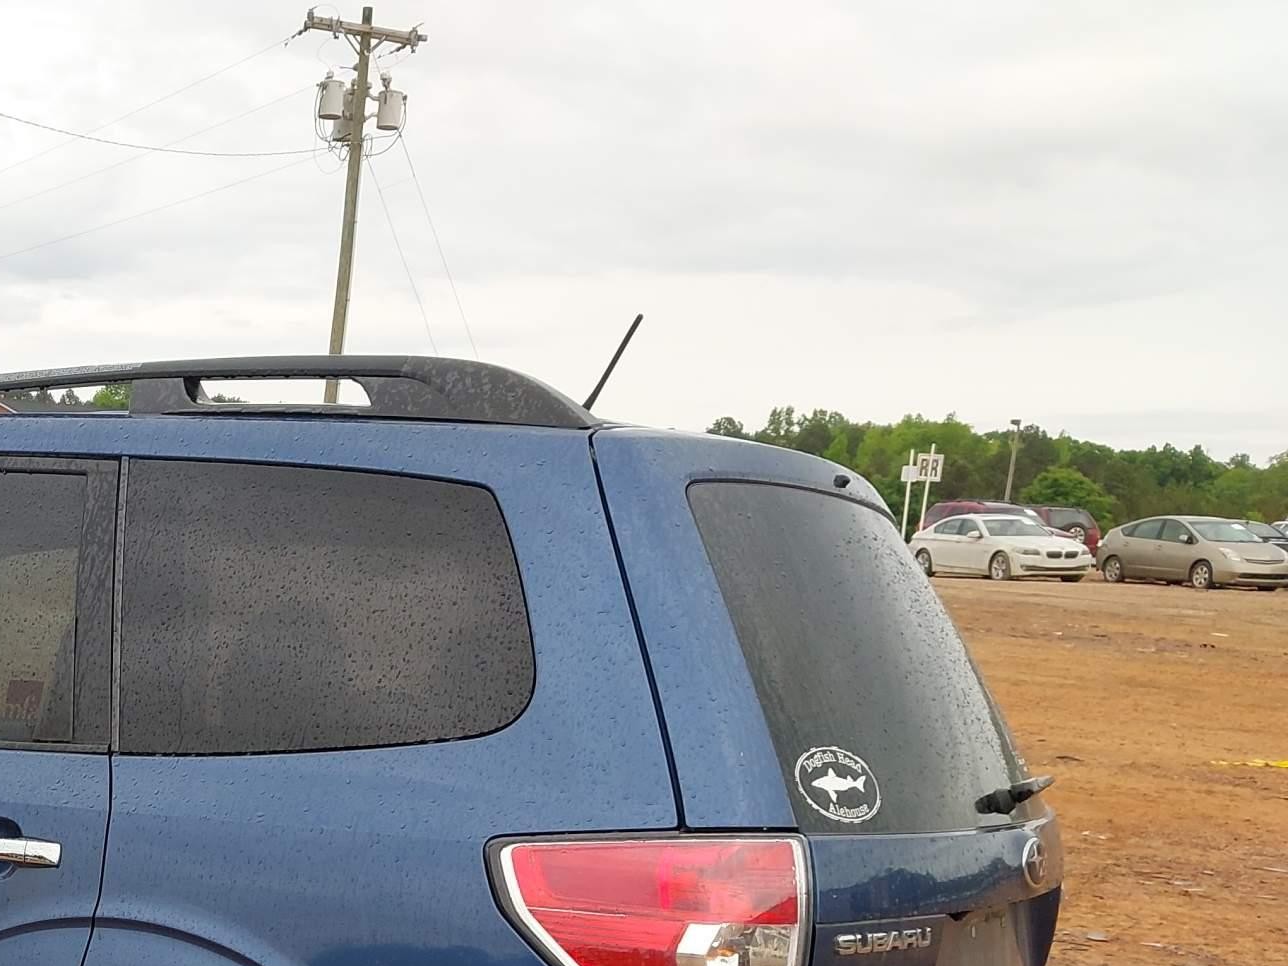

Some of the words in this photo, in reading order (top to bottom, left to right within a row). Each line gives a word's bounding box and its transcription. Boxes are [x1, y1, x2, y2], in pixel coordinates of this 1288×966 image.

[803, 751, 837, 773] Dogfish
[836, 752, 863, 774] Head
[828, 802, 870, 818] Alehouse
[835, 927, 932, 956] SUBARU
